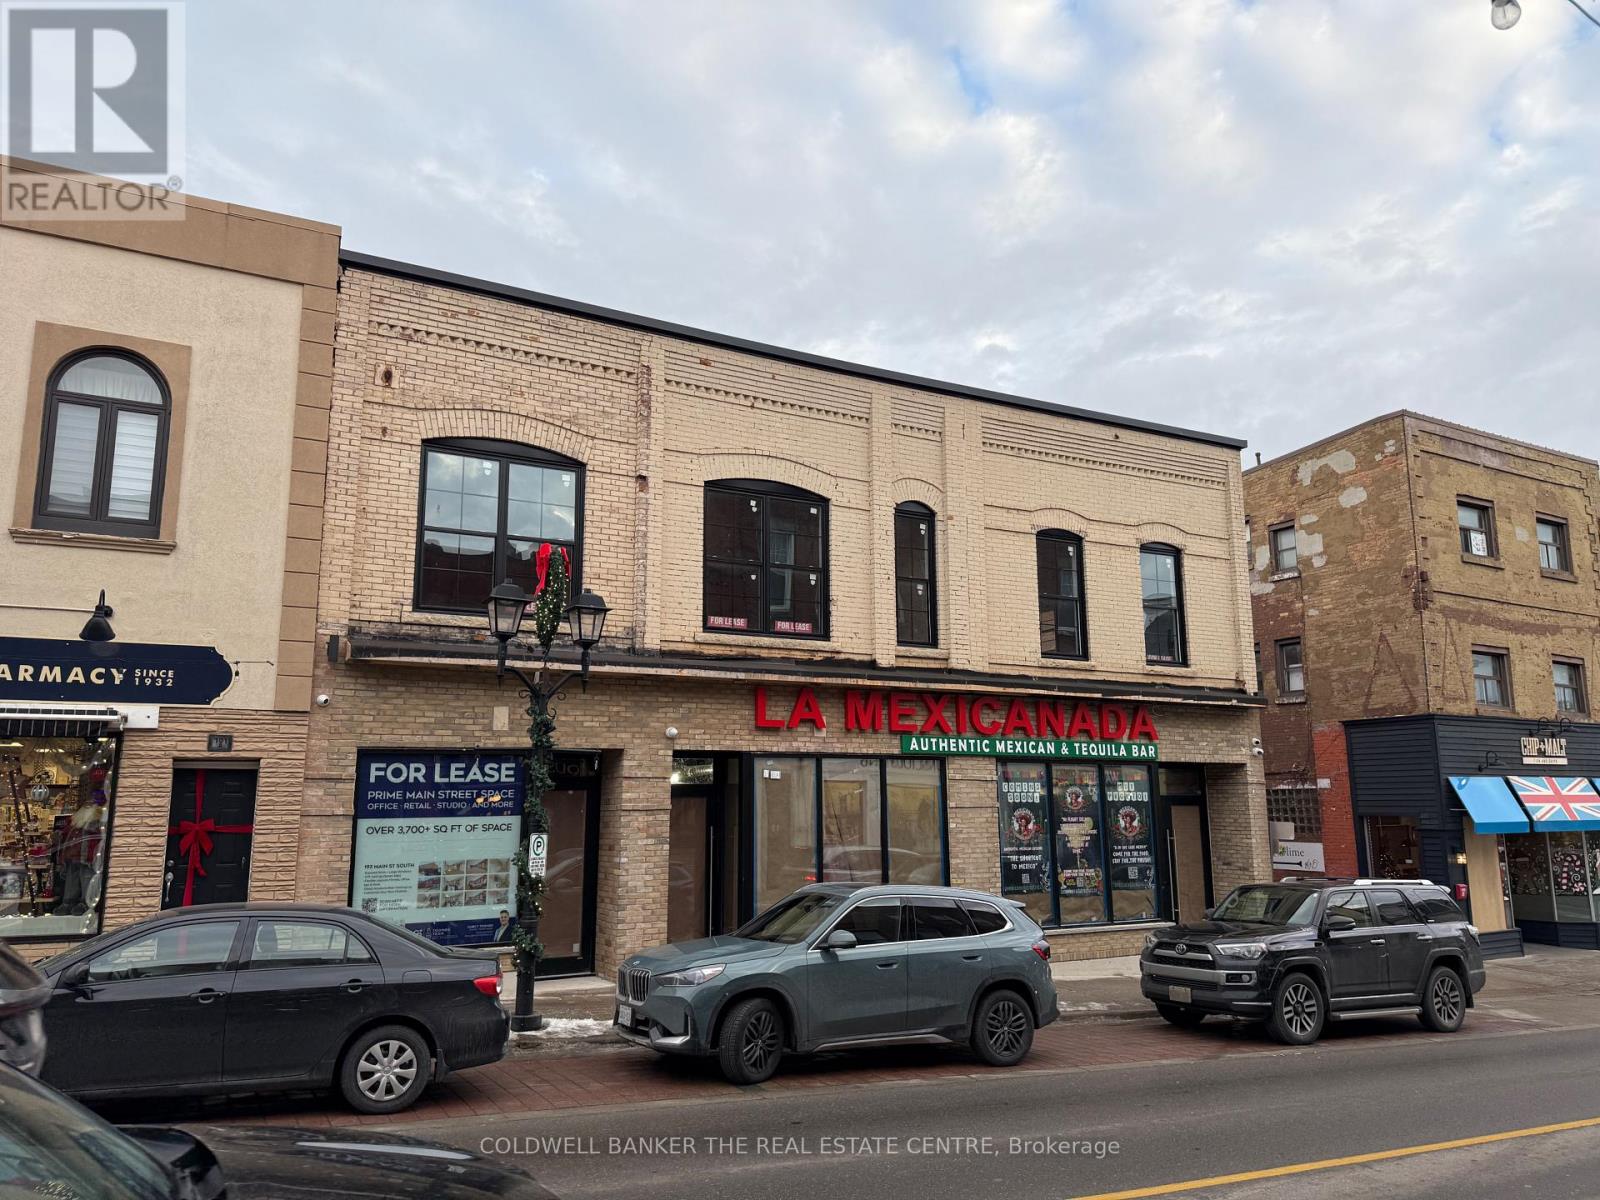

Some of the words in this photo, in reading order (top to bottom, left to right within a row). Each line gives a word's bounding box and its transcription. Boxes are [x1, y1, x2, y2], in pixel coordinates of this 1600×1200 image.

[710, 616, 724, 625] FOR
[724, 617, 745, 626] LEASE
[777, 621, 790, 630] FOR
[790, 622, 811, 631] LEASE
[134, 668, 175, 678] SINCE
[134, 678, 174, 687] 1932
[754, 687, 827, 730] LA
[844, 689, 1159, 741] MEXICANADA
[909, 737, 990, 753] AUTHENTIC
[996, 741, 1055, 755] MEXICAN
[1061, 742, 1069, 754] &
[1074, 743, 1126, 757] TEQUILA
[1132, 745, 1156, 758] BAR
[369, 762, 427, 783] FOR
[434, 762, 516, 783] LEASE
[367, 790, 403, 800] PRIME
[406, 790, 435, 800] MAIN
[437, 789, 478, 799] STREET
[480, 789, 515, 799] SPACE
[367, 802, 398, 810] OFFICE
[404, 802, 431, 810] RETAIL
[366, 826, 395, 835] OVER
[397, 825, 431, 835] 3,700+
[433, 824, 448, 834] SQ
[451, 824, 463, 833] FT
[465, 824, 479, 833] OF
[481, 823, 512, 832] SPACE
[1286, 846, 1305, 857] lime
